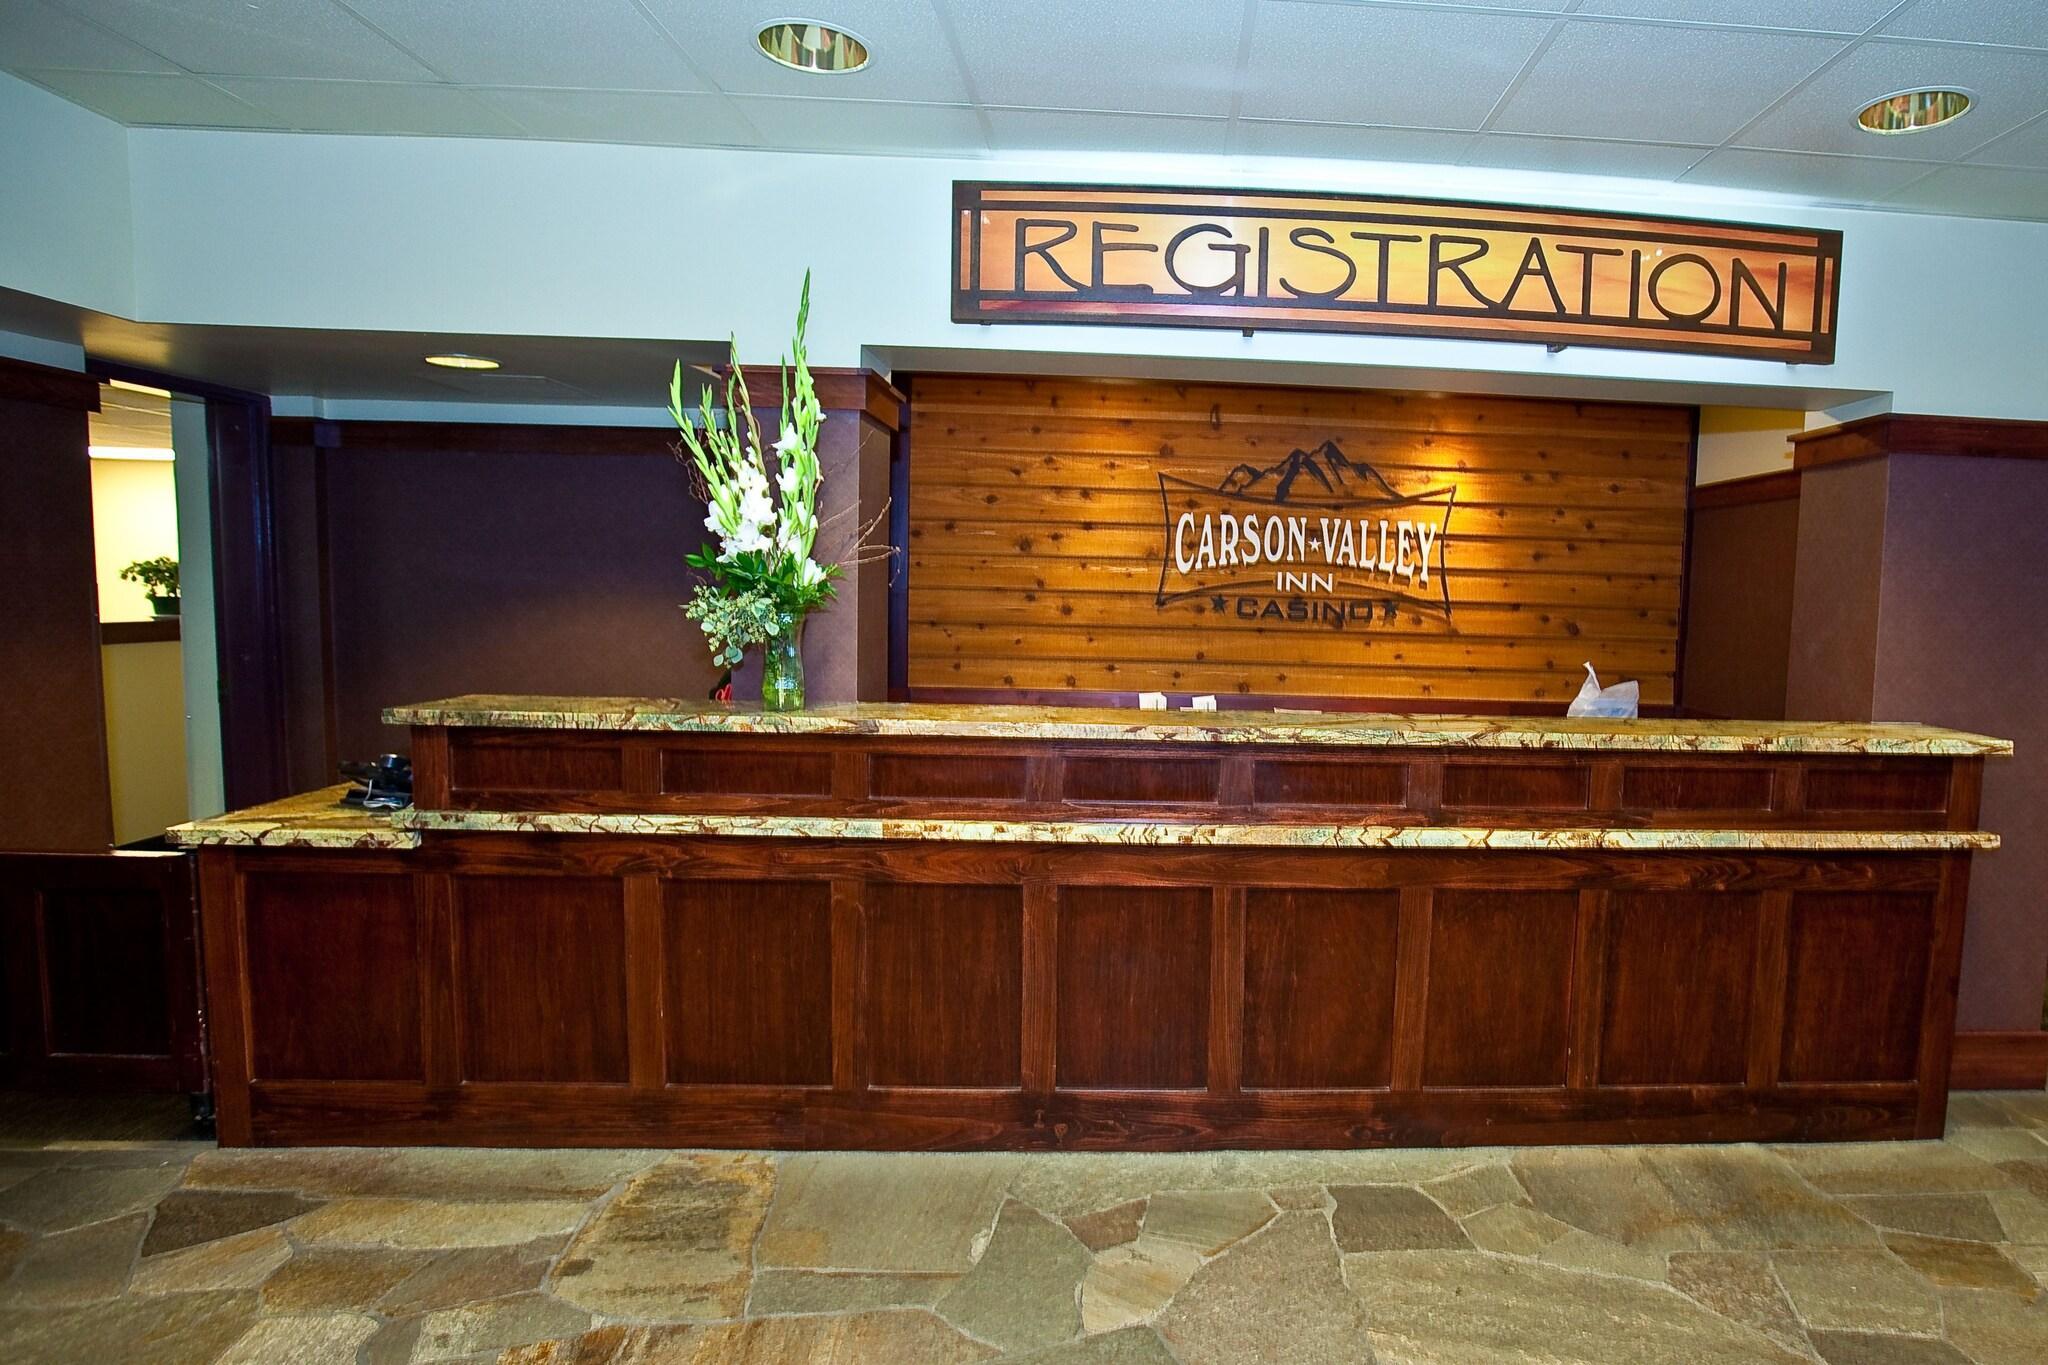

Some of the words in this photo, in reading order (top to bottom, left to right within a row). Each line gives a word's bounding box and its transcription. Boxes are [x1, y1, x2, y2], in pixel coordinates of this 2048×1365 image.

[1014, 217, 1790, 332] REGISTRATION
[1175, 512, 1307, 575] CARSON
[1320, 517, 1437, 584] VALLEY
[1276, 571, 1334, 593] INN
[1236, 599, 1374, 621] CASINO
